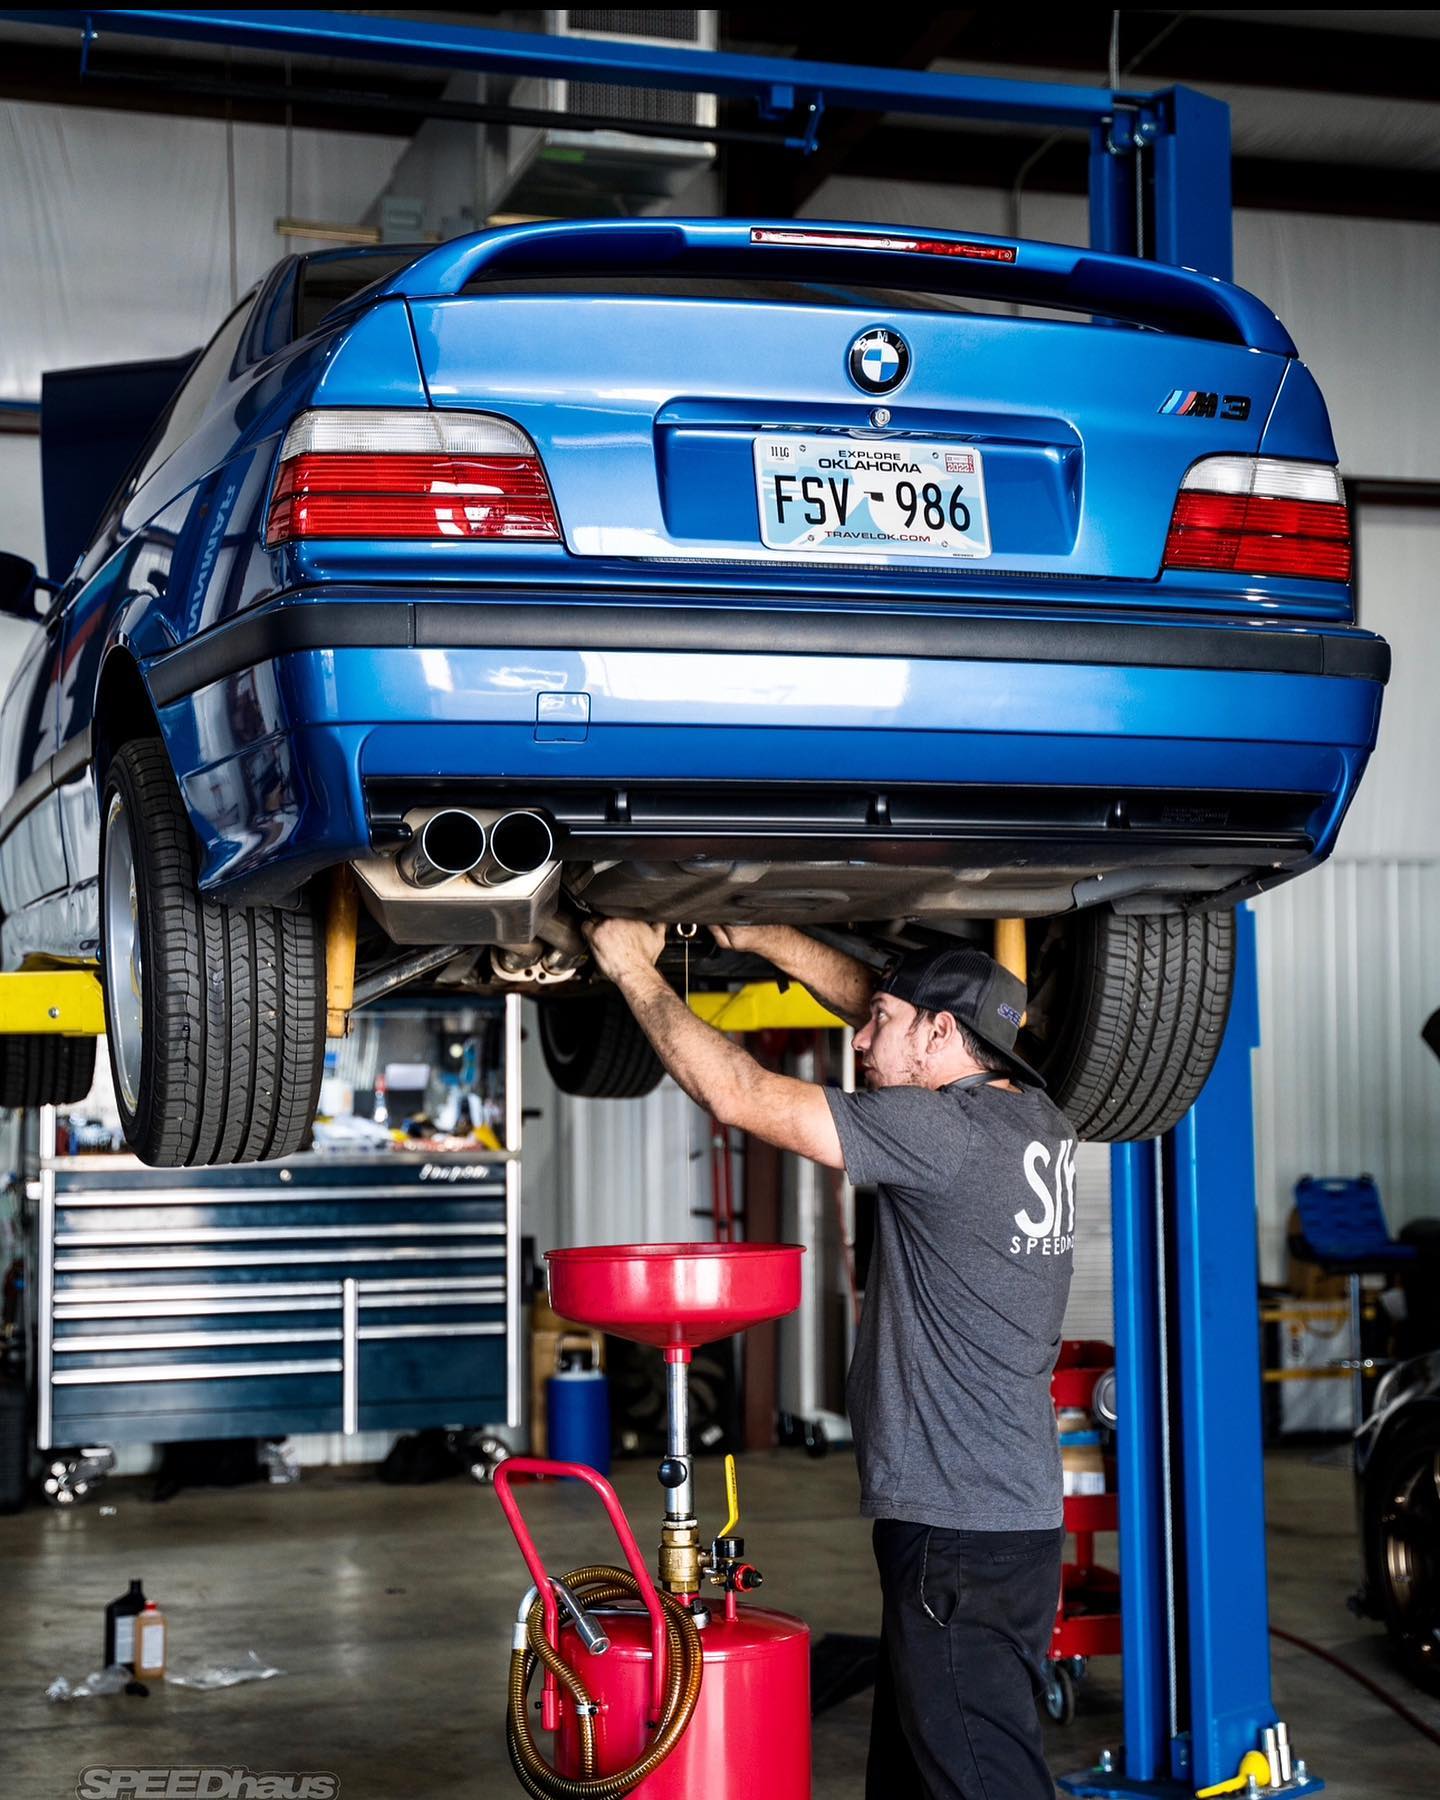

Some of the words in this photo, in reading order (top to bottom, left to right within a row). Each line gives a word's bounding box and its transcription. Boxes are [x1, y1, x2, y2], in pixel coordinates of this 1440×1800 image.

[1183, 390, 1252, 421] M3
[838, 450, 902, 461] EXPLORE
[818, 458, 922, 474] OKLAHOMA
[774, 475, 849, 526] FSV
[895, 481, 971, 532] 986
[824, 530, 931, 543] TRAVELOK.COM
